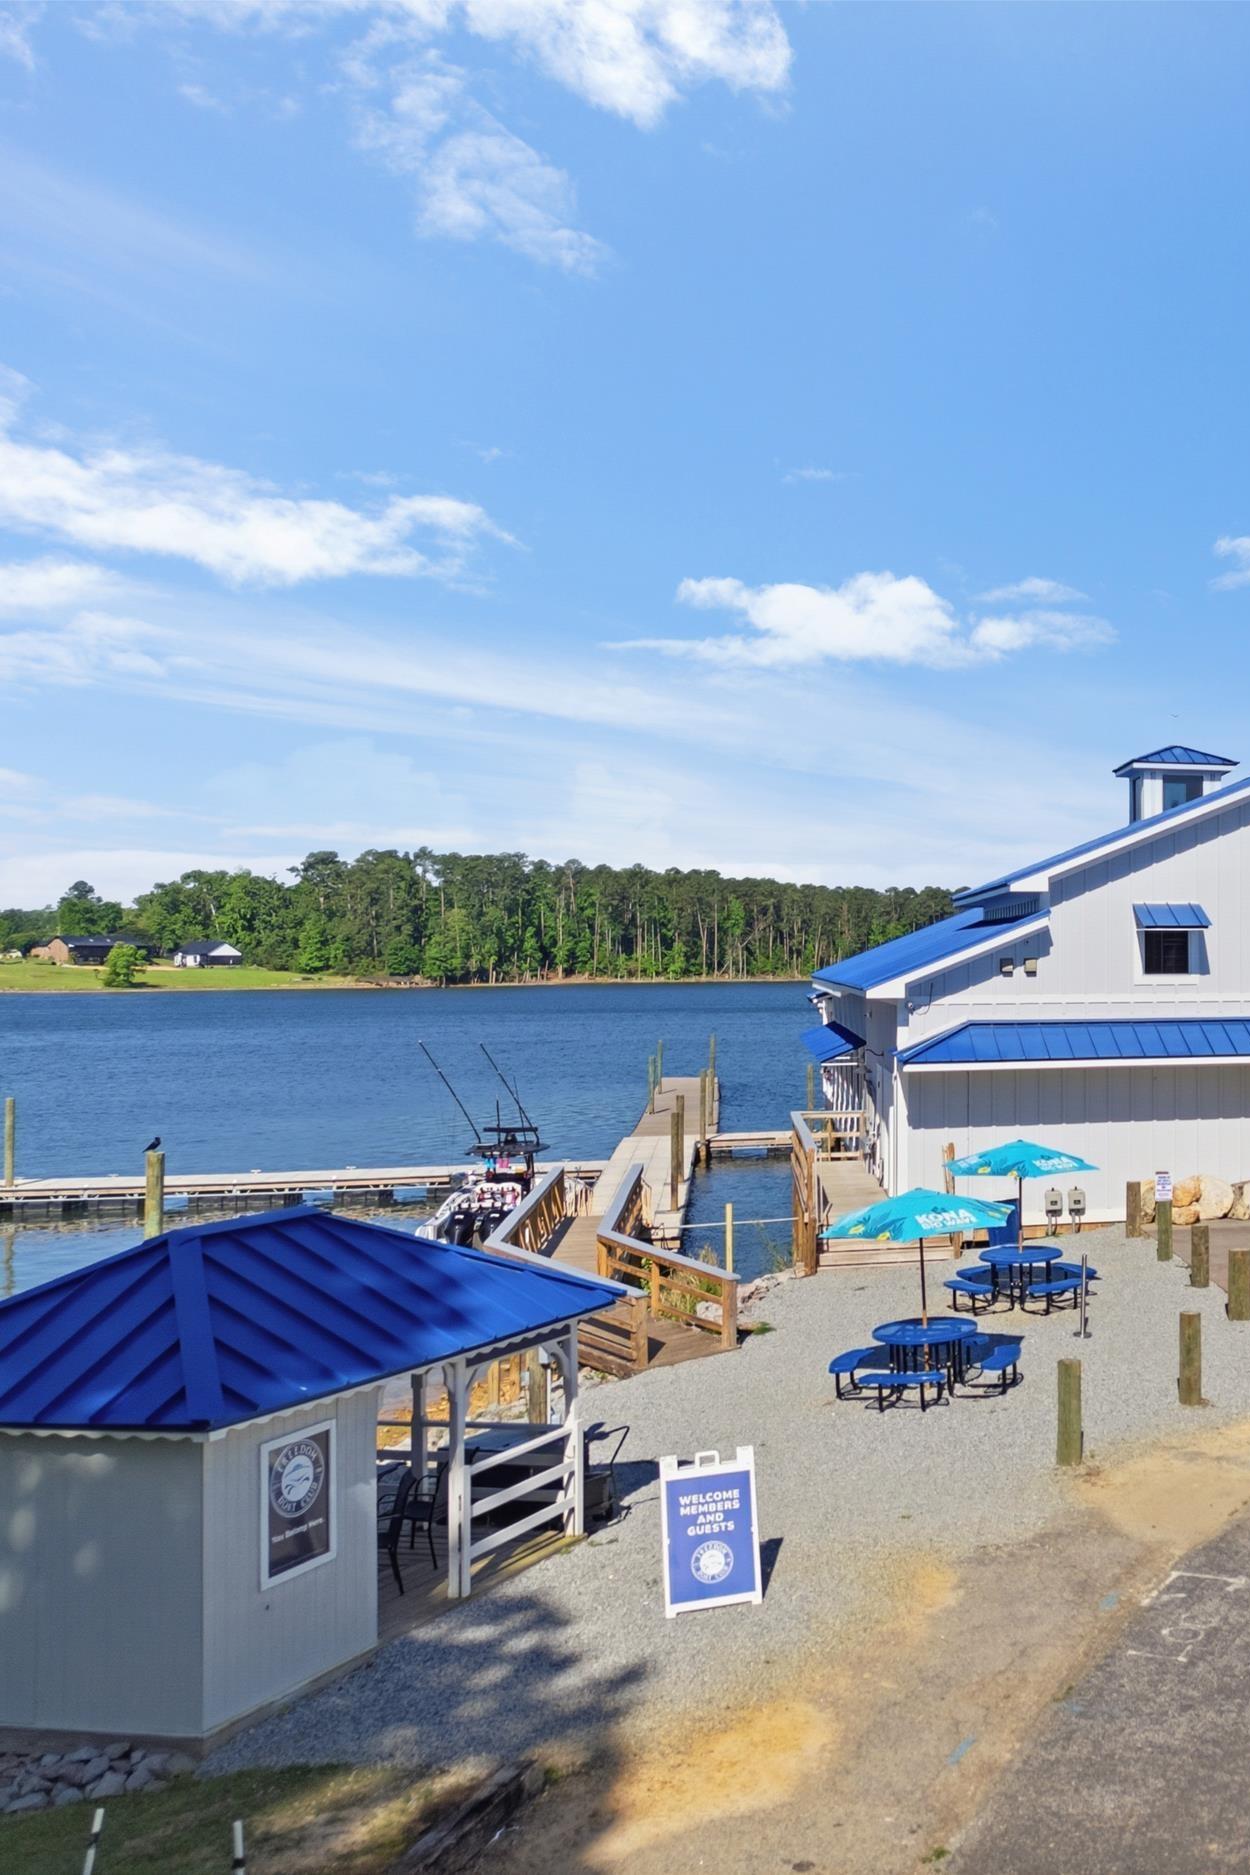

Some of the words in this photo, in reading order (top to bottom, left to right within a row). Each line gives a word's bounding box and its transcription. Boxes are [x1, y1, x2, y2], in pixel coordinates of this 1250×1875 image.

[914, 1208, 977, 1225] KONA
[679, 1488, 740, 1506] WELCOME
[680, 1499, 741, 1517] MEMBERS
[696, 1512, 724, 1525] AND
[687, 1520, 735, 1537] GUESTS
